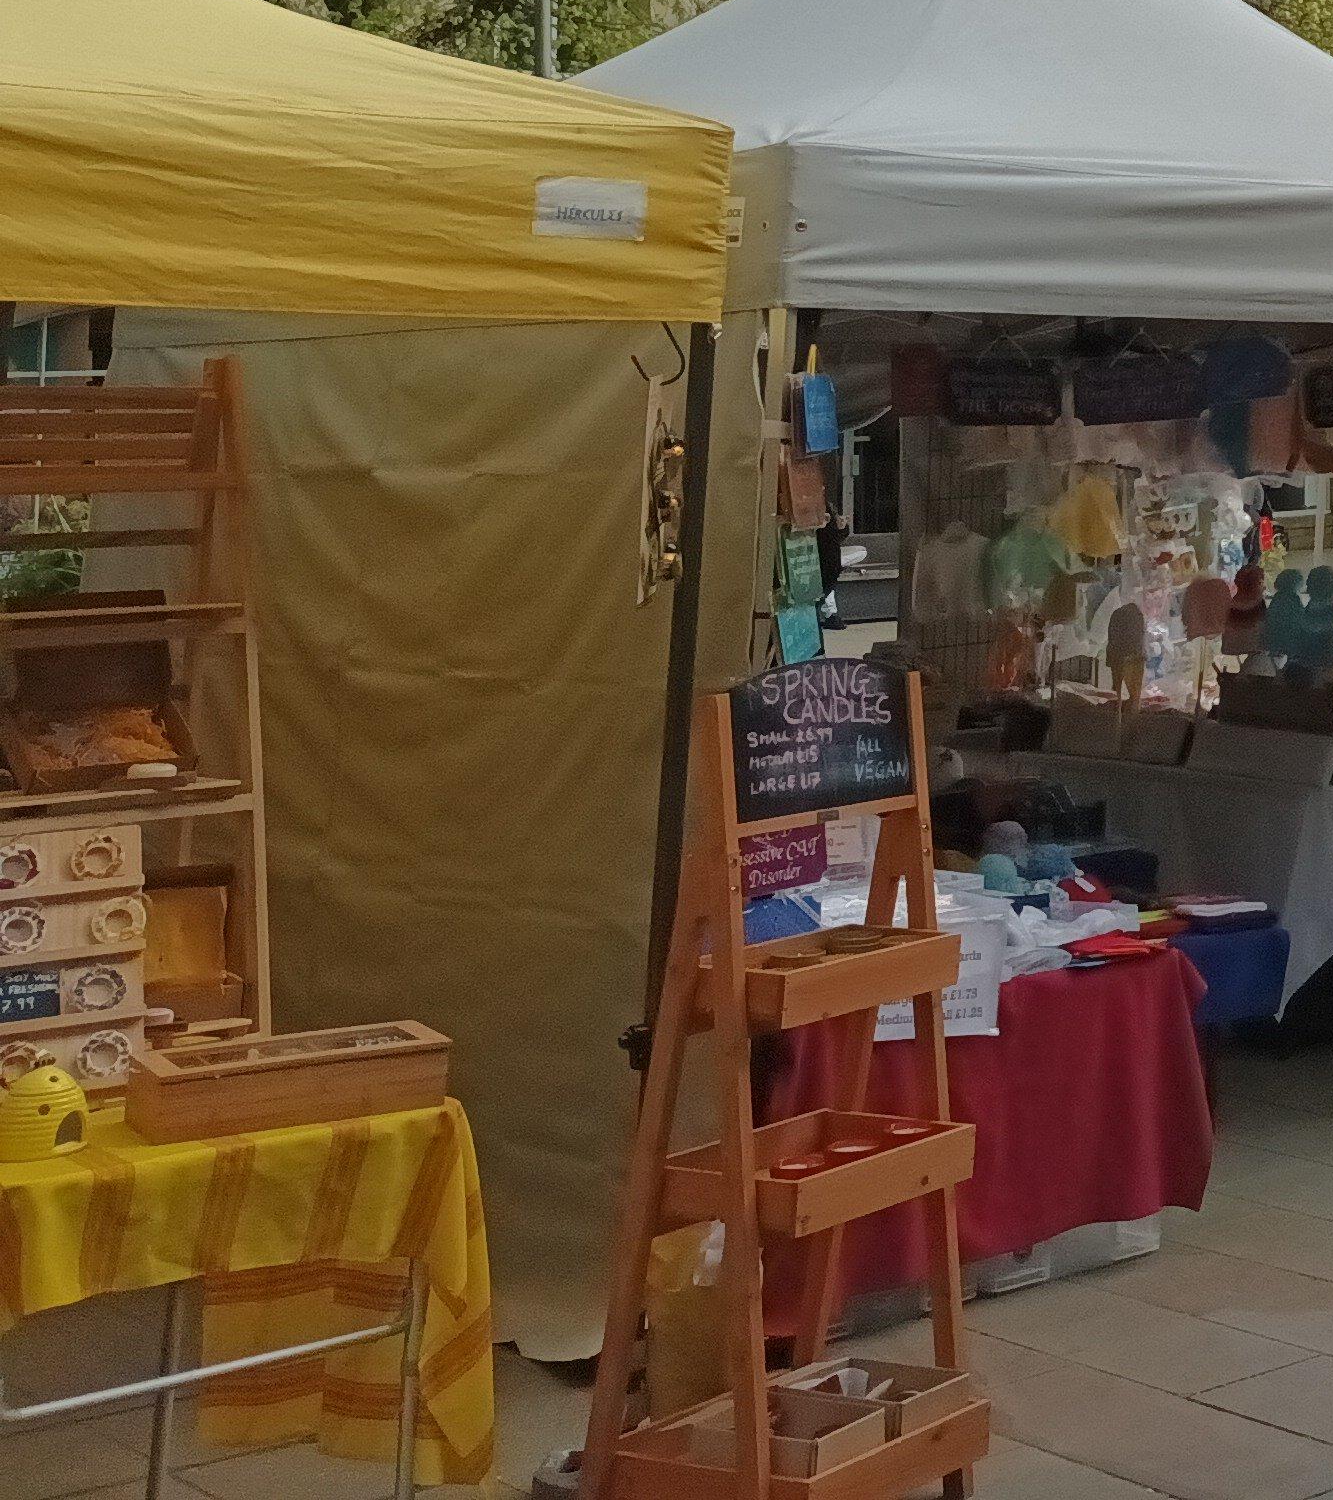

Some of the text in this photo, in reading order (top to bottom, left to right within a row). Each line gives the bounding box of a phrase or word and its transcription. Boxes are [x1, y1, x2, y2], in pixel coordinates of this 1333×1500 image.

[555, 205, 623, 223] HERCULES
[761, 662, 870, 706] SPRING
[782, 694, 892, 725] CANDLES
[746, 729, 791, 748] SMALL
[854, 757, 909, 783] VEGAN
[750, 774, 797, 795] LARGE
